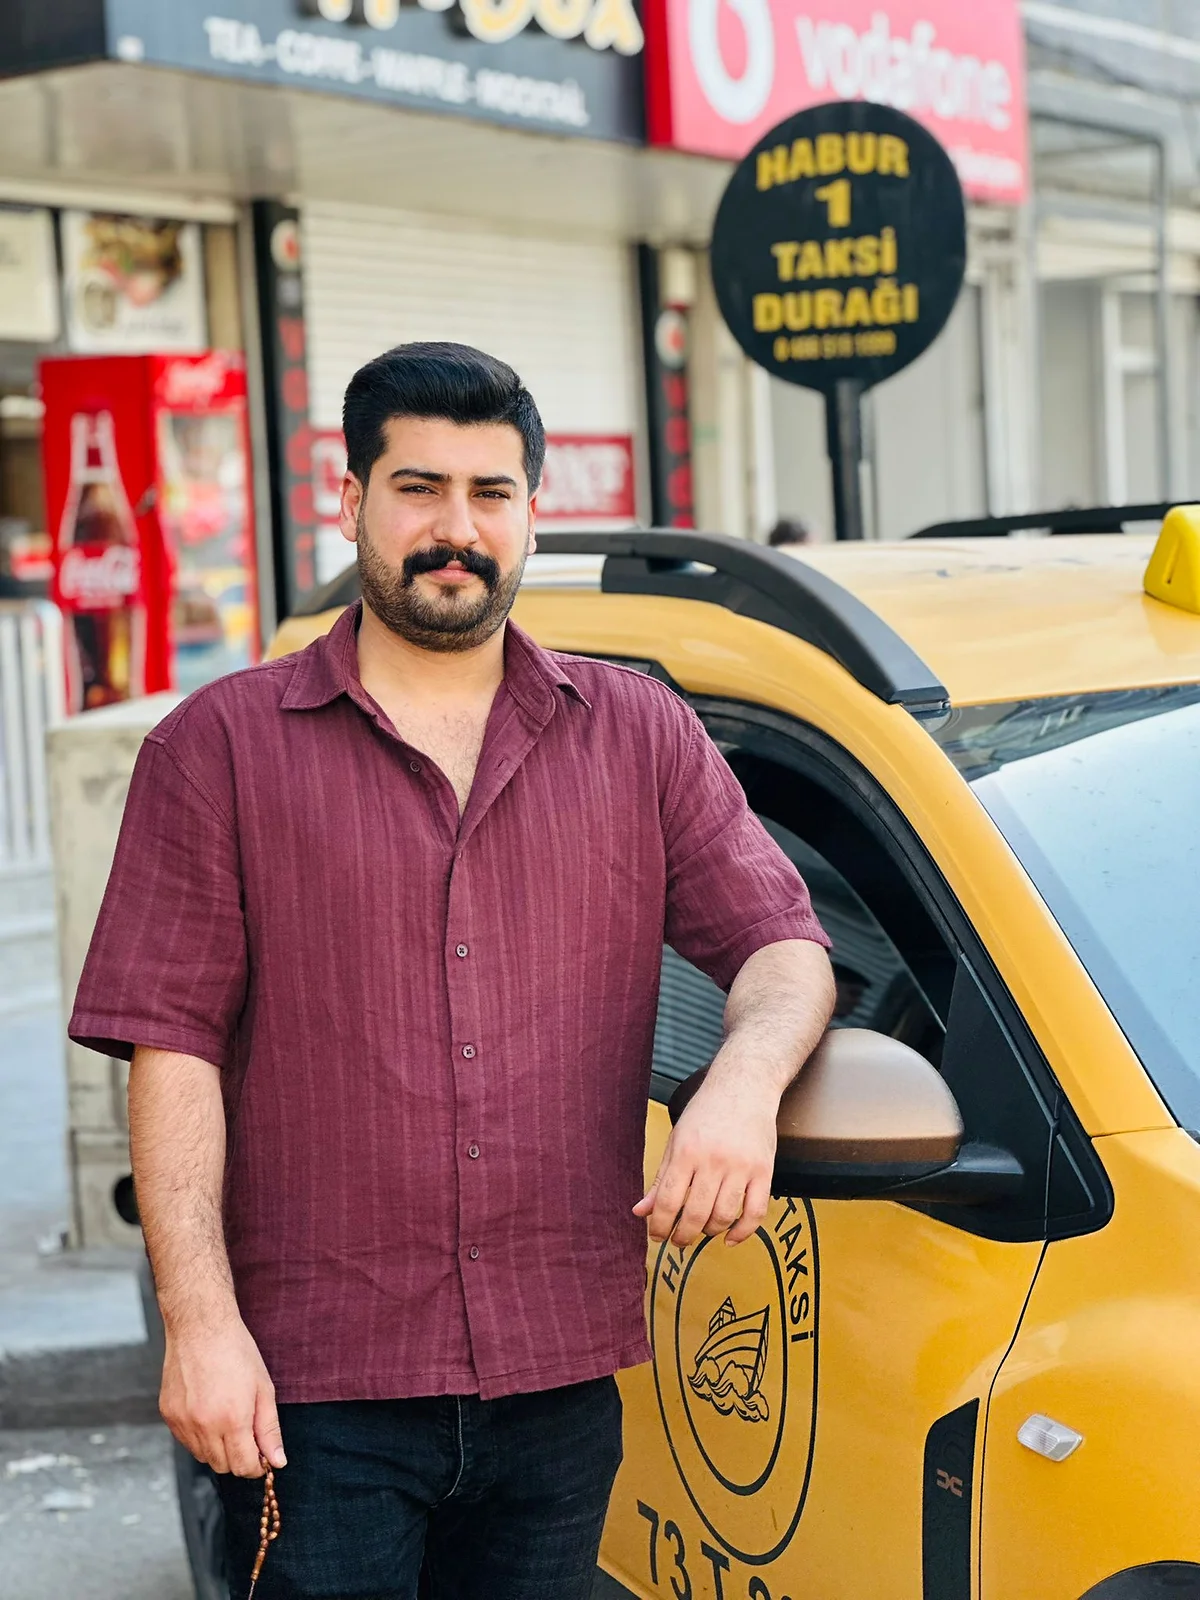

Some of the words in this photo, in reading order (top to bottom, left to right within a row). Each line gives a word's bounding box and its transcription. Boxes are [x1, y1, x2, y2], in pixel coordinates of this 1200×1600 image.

[757, 132, 910, 191] HABUR
[815, 179, 851, 228] 1
[770, 226, 897, 282] TAKSİ
[753, 277, 919, 332] DURAĞI
[775, 1196, 814, 1343] TAKSİ
